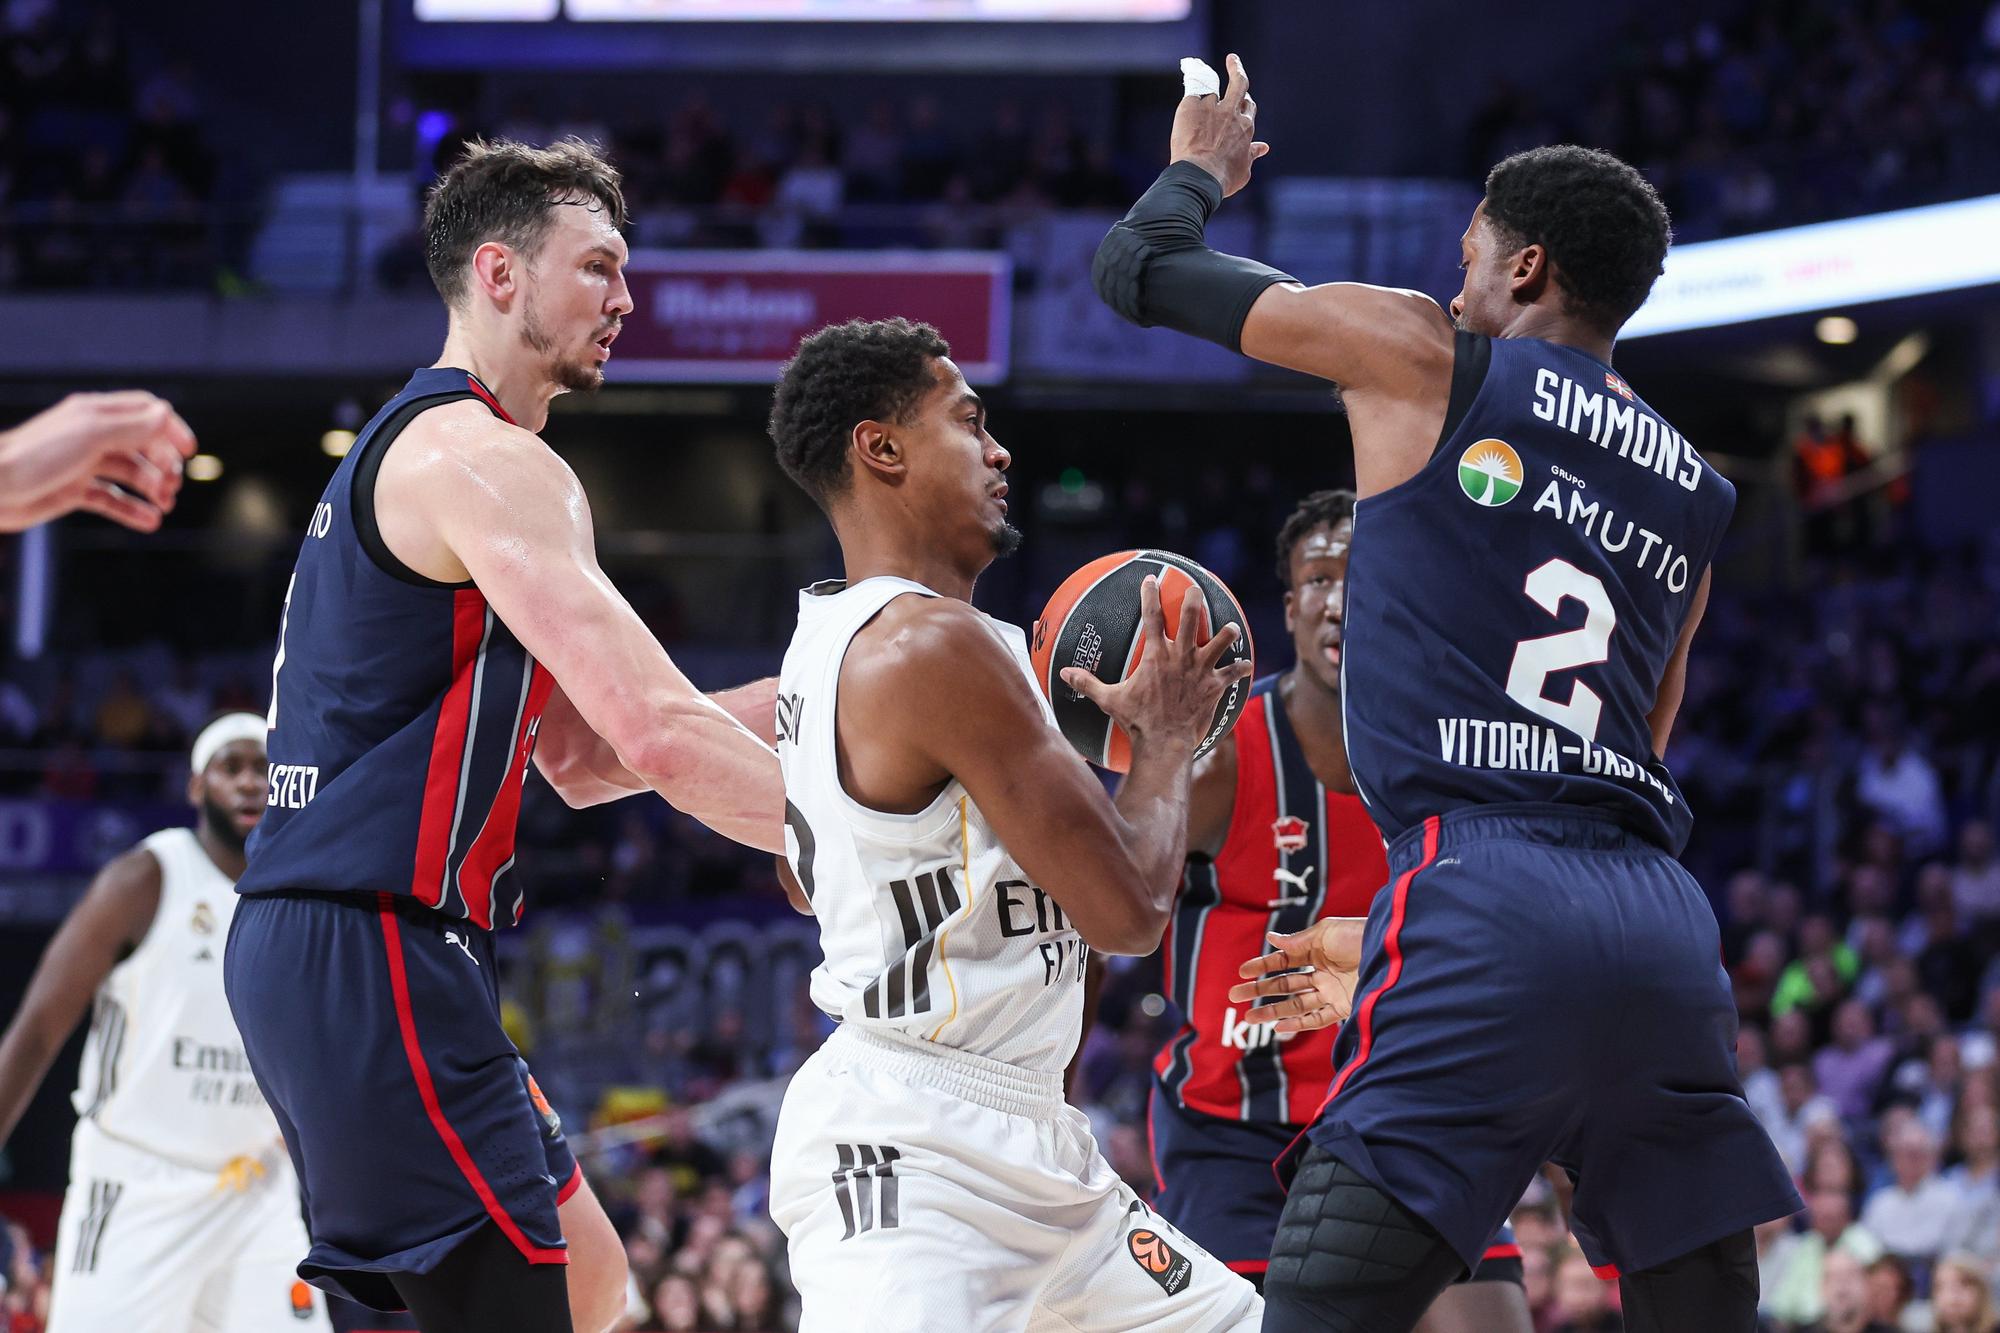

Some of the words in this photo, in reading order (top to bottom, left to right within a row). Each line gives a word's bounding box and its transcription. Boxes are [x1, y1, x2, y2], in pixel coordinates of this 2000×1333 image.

[1533, 368, 1702, 492] SIMMONS
[1551, 465, 1586, 490] GRUPO
[1533, 480, 1688, 594] AMUTIO
[1504, 558, 1617, 744] 2
